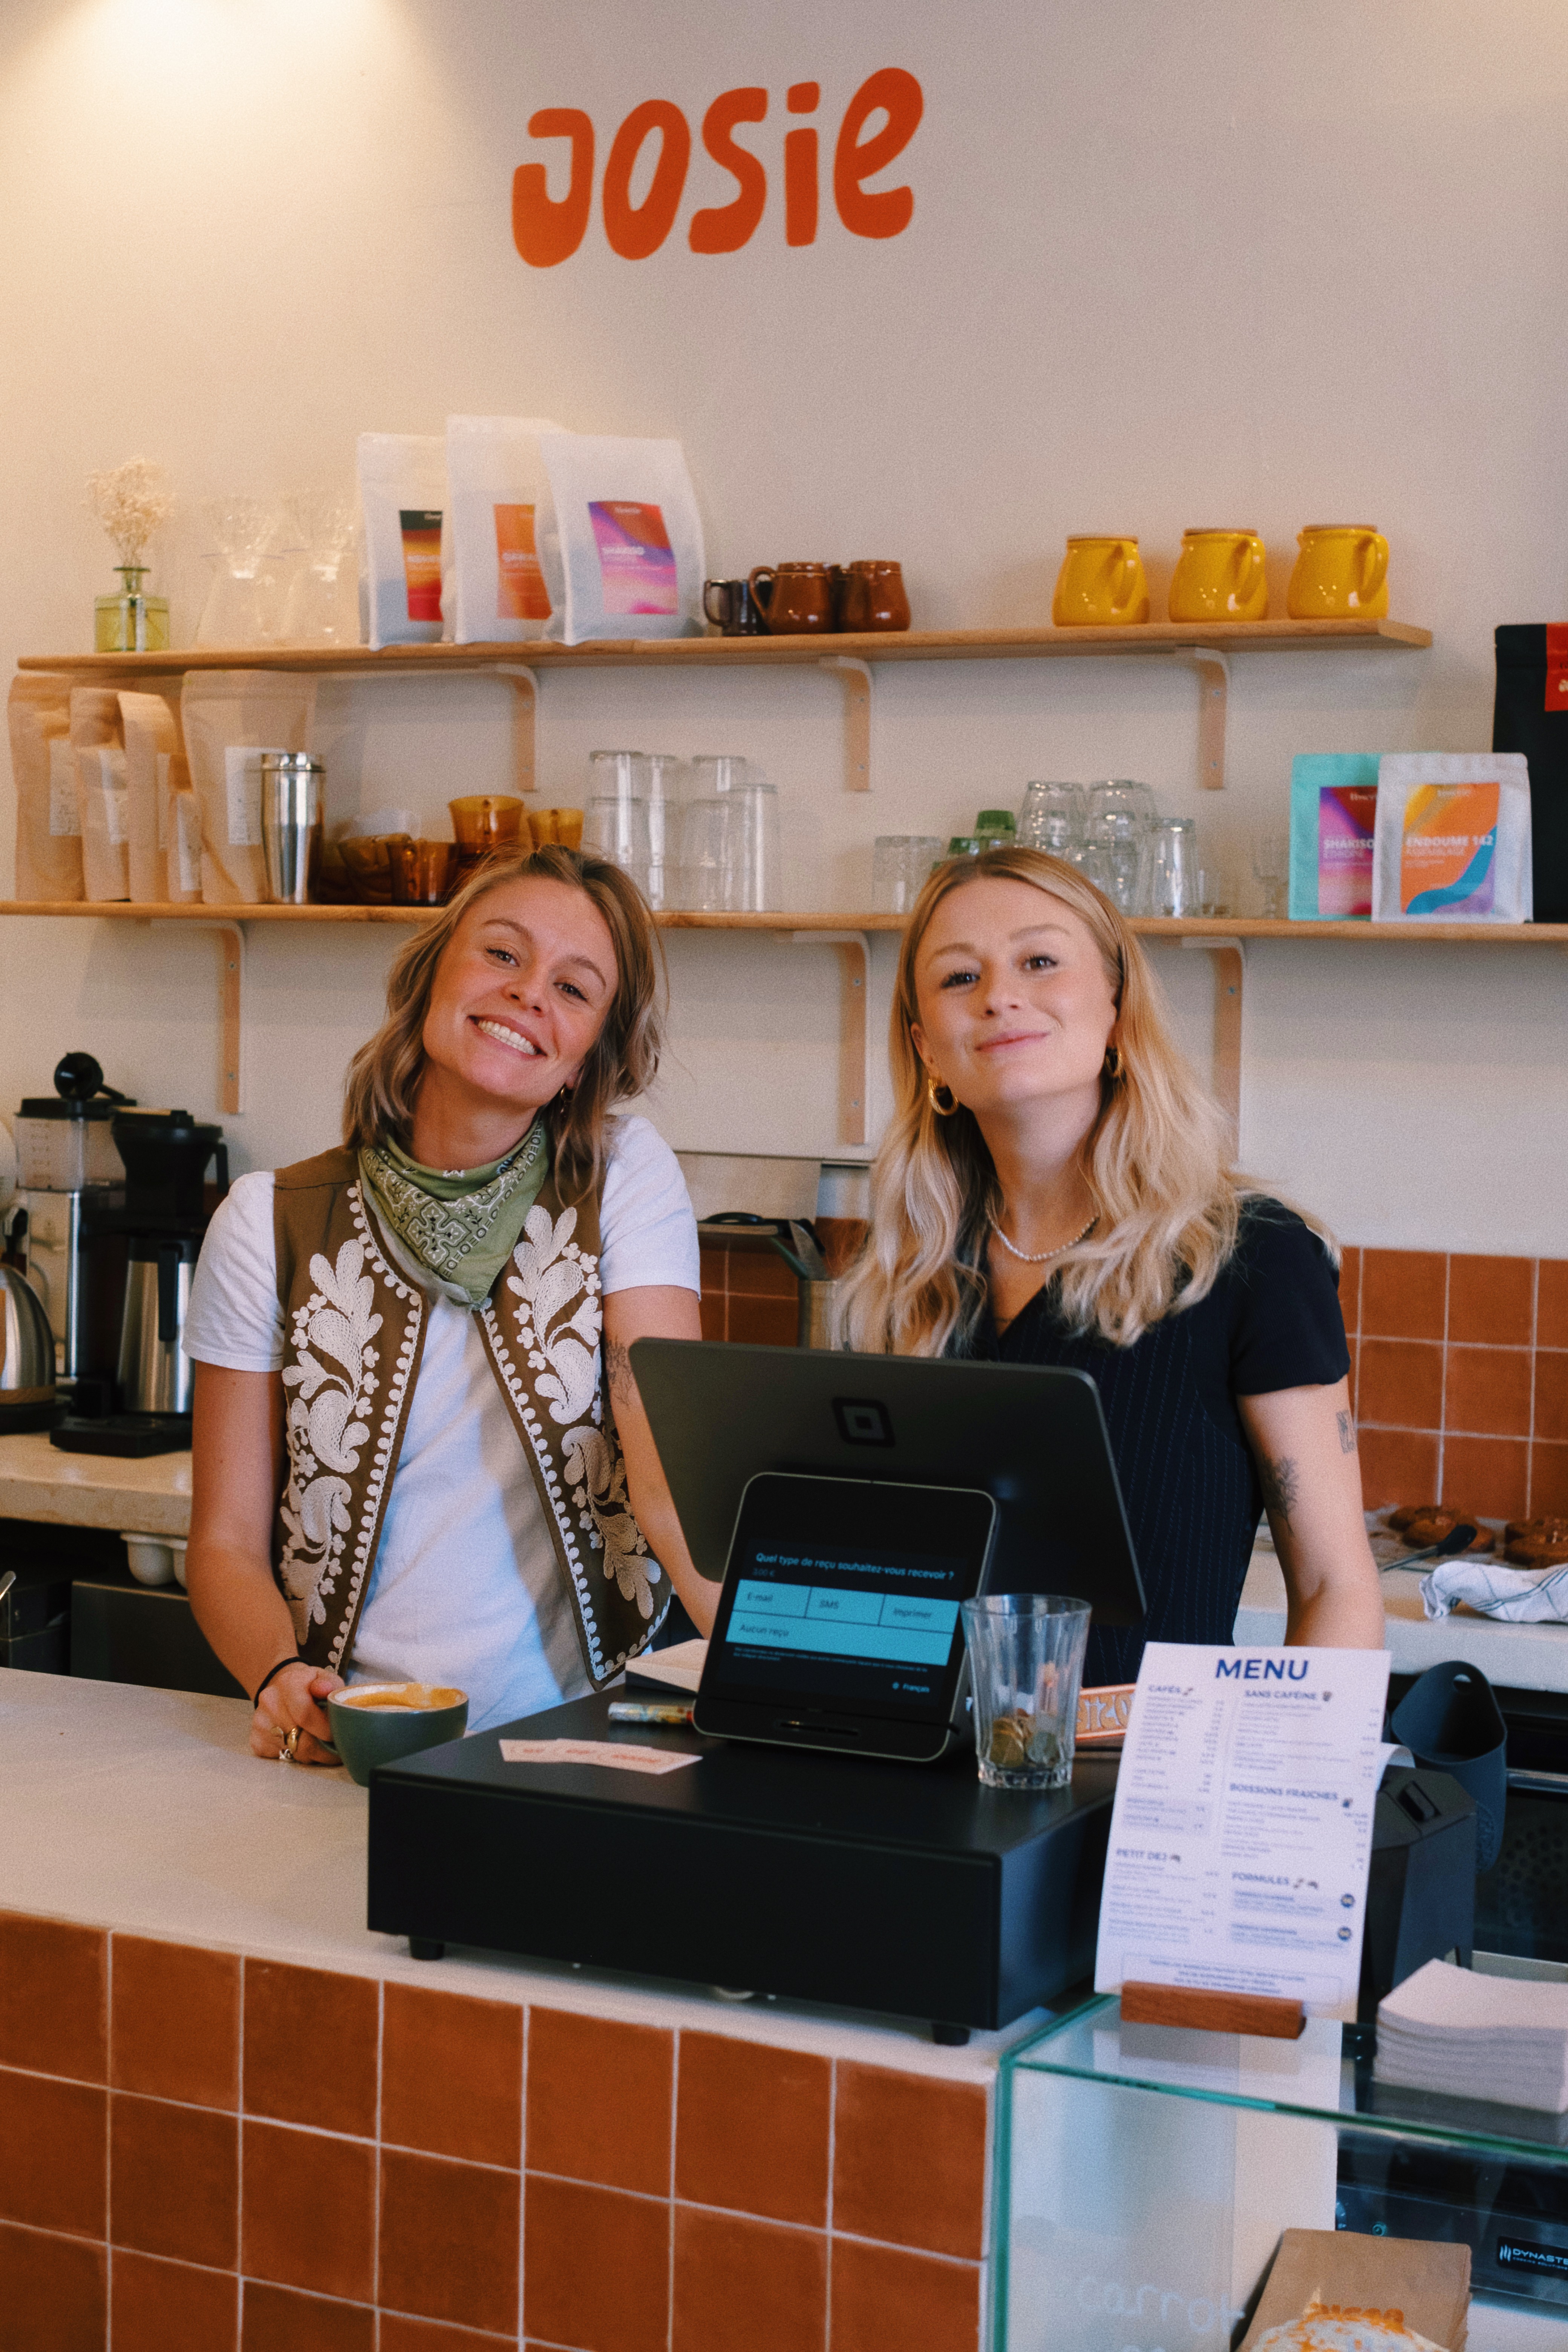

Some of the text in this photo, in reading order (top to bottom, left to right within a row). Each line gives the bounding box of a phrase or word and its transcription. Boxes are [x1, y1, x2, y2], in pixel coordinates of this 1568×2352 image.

[756, 1553, 954, 1580] Quel type de reçu souhaitez-vous recevoir ?
[747, 1592, 772, 1602] E-mail
[819, 1600, 839, 1610] SMS
[893, 1608, 932, 1621] Imprimer
[740, 1625, 789, 1638] Aucun reçu
[1215, 1658, 1309, 1681] MENU
[903, 1683, 929, 1693] Français
[1245, 1689, 1272, 1700] SANS
[1230, 1783, 1284, 1797] BOISSONS
[1116, 1848, 1145, 1860] PETIT
[1233, 1873, 1289, 1885] FORMULES
